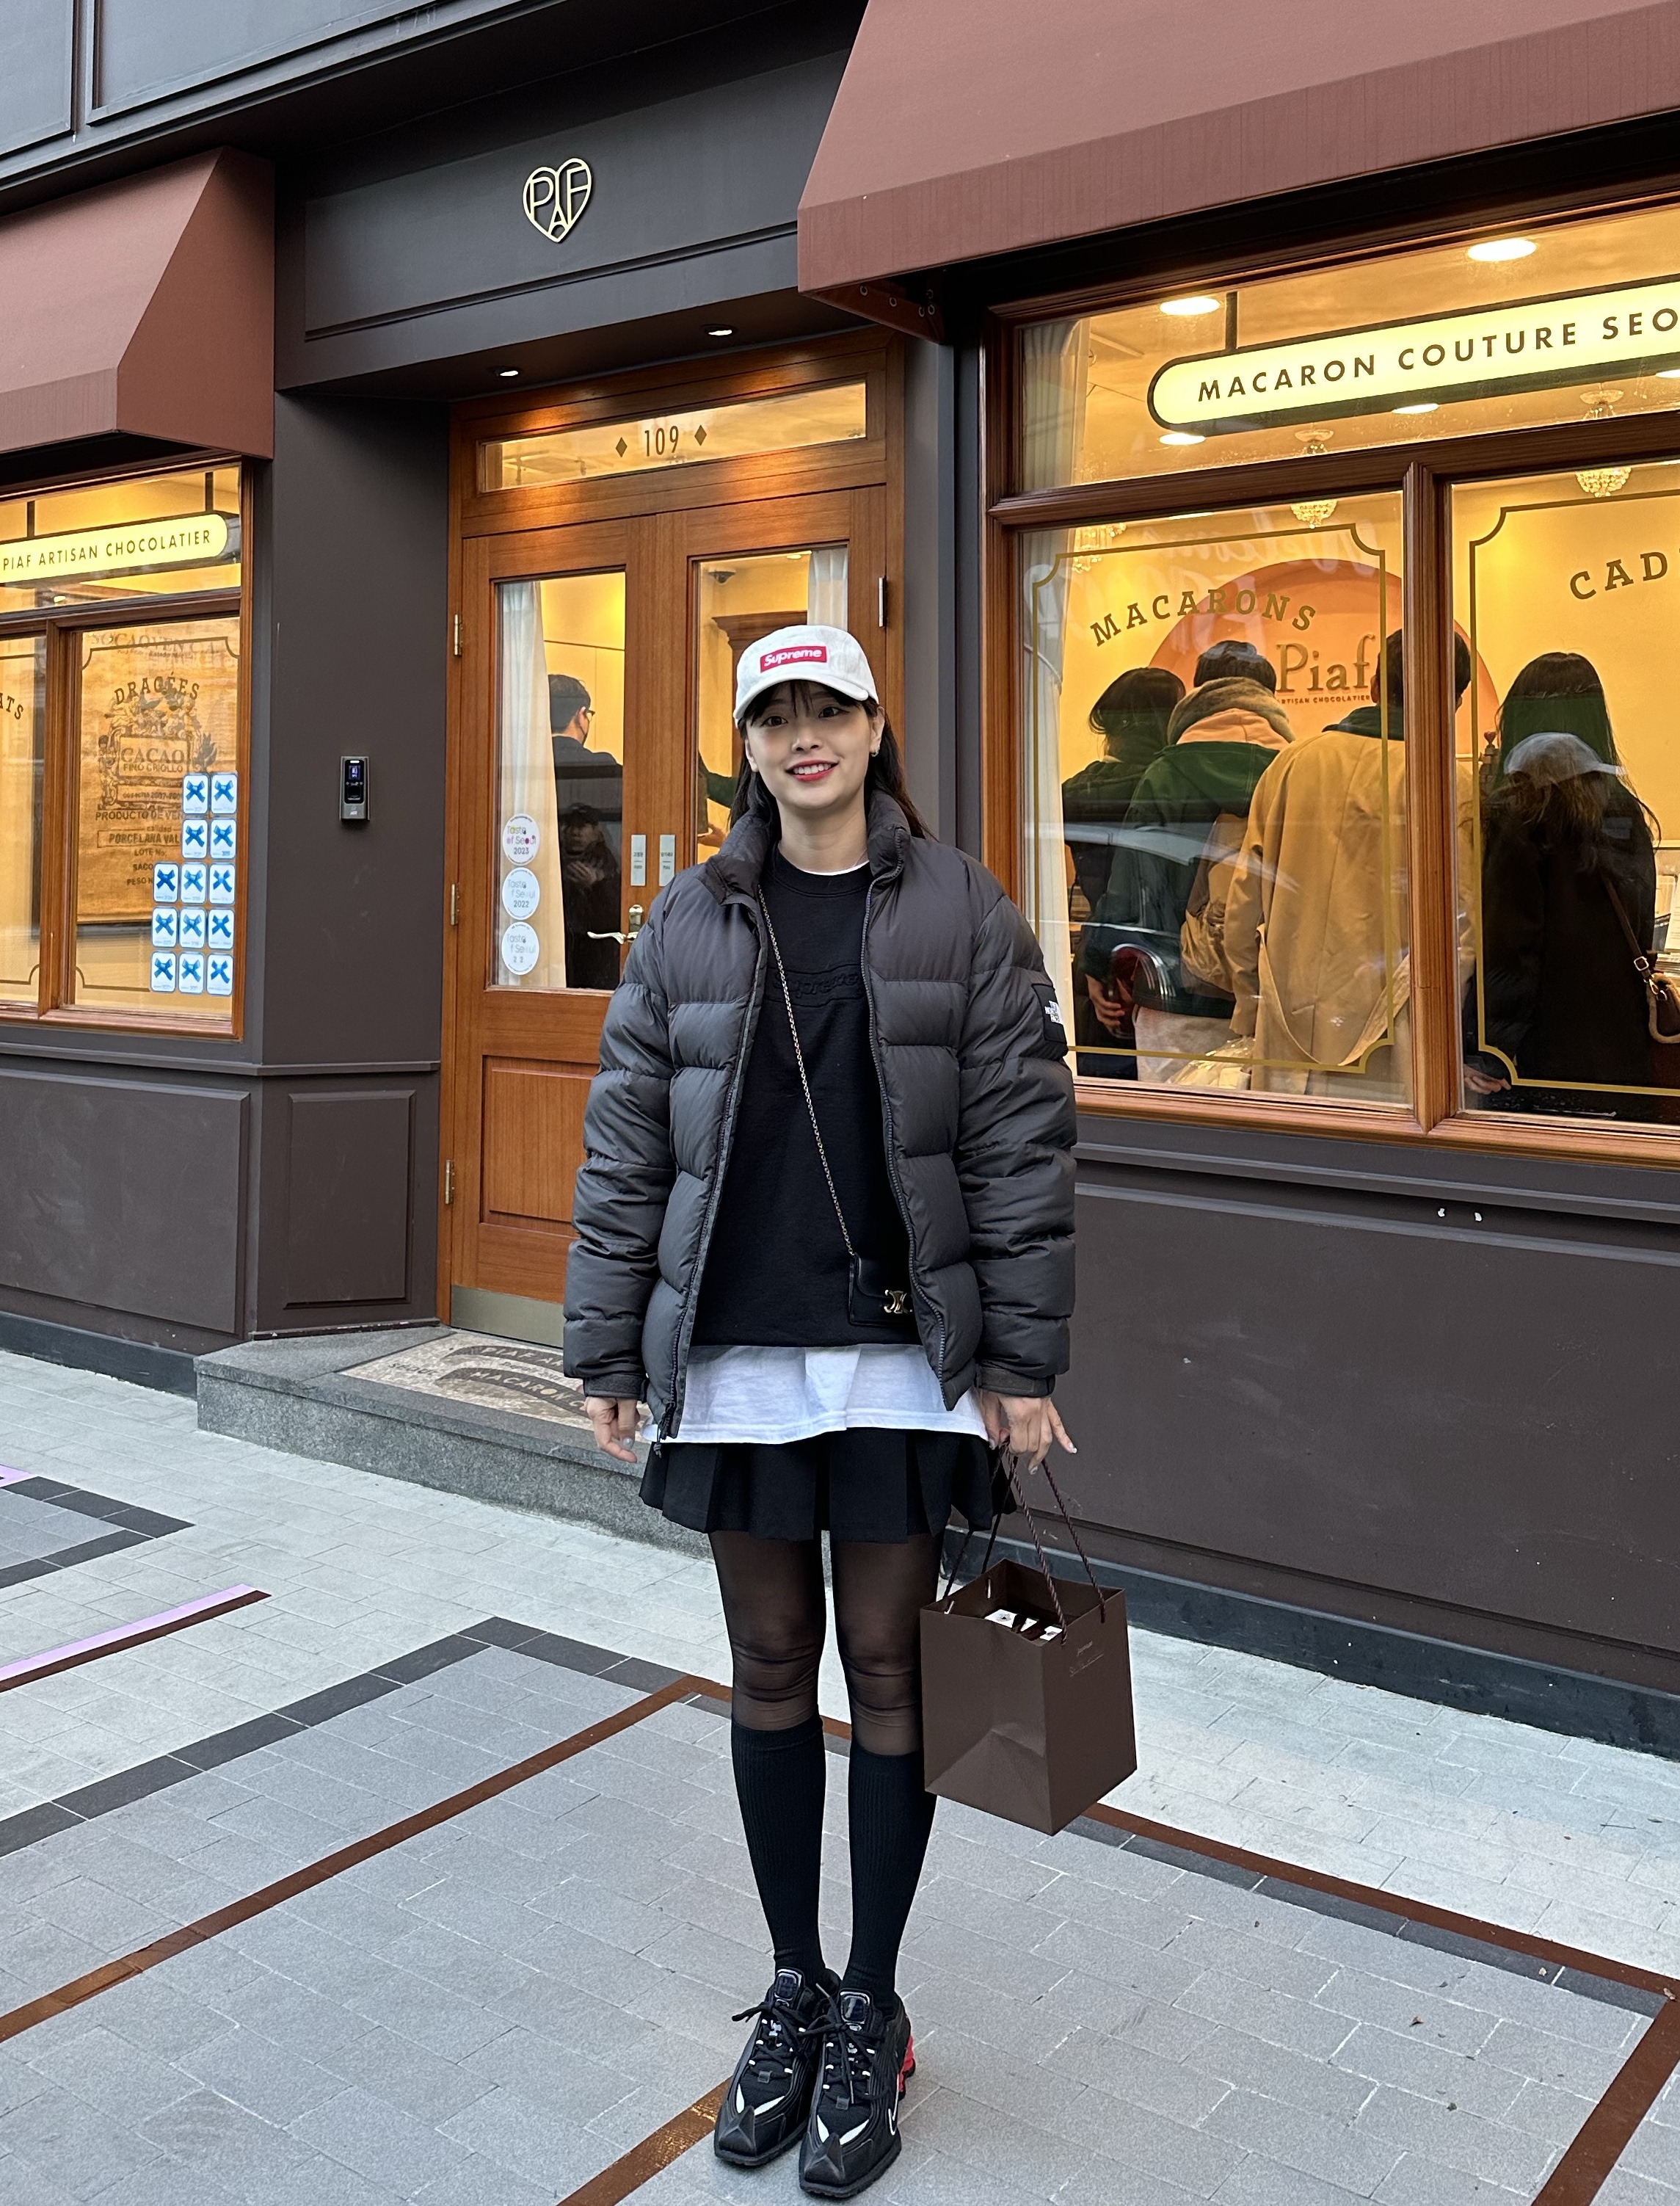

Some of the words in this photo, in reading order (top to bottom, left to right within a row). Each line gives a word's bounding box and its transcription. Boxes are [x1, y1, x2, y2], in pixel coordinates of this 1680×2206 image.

[1198, 355, 1375, 402] MACARON
[1398, 322, 1577, 371] COUTURE
[644, 426, 679, 457] 109
[3, 554, 32, 570] PIAF
[39, 545, 98, 565] ARTISAN
[106, 530, 210, 556] CHOCOLATIER
[1570, 548, 1680, 600] CAD
[1090, 588, 1316, 647] MACARONS
[764, 649, 822, 667] Supreme
[1276, 634, 1375, 692] Piaf
[114, 671, 200, 705] DRAGÉES
[1313, 694, 1370, 703] CHOCOLATIER
[121, 747, 184, 763] CACAO
[95, 811, 148, 821] PRODUCTO
[513, 900, 529, 908] 2022
[481, 1347, 537, 1358] PIAF
[470, 1371, 572, 1401] MACARON
